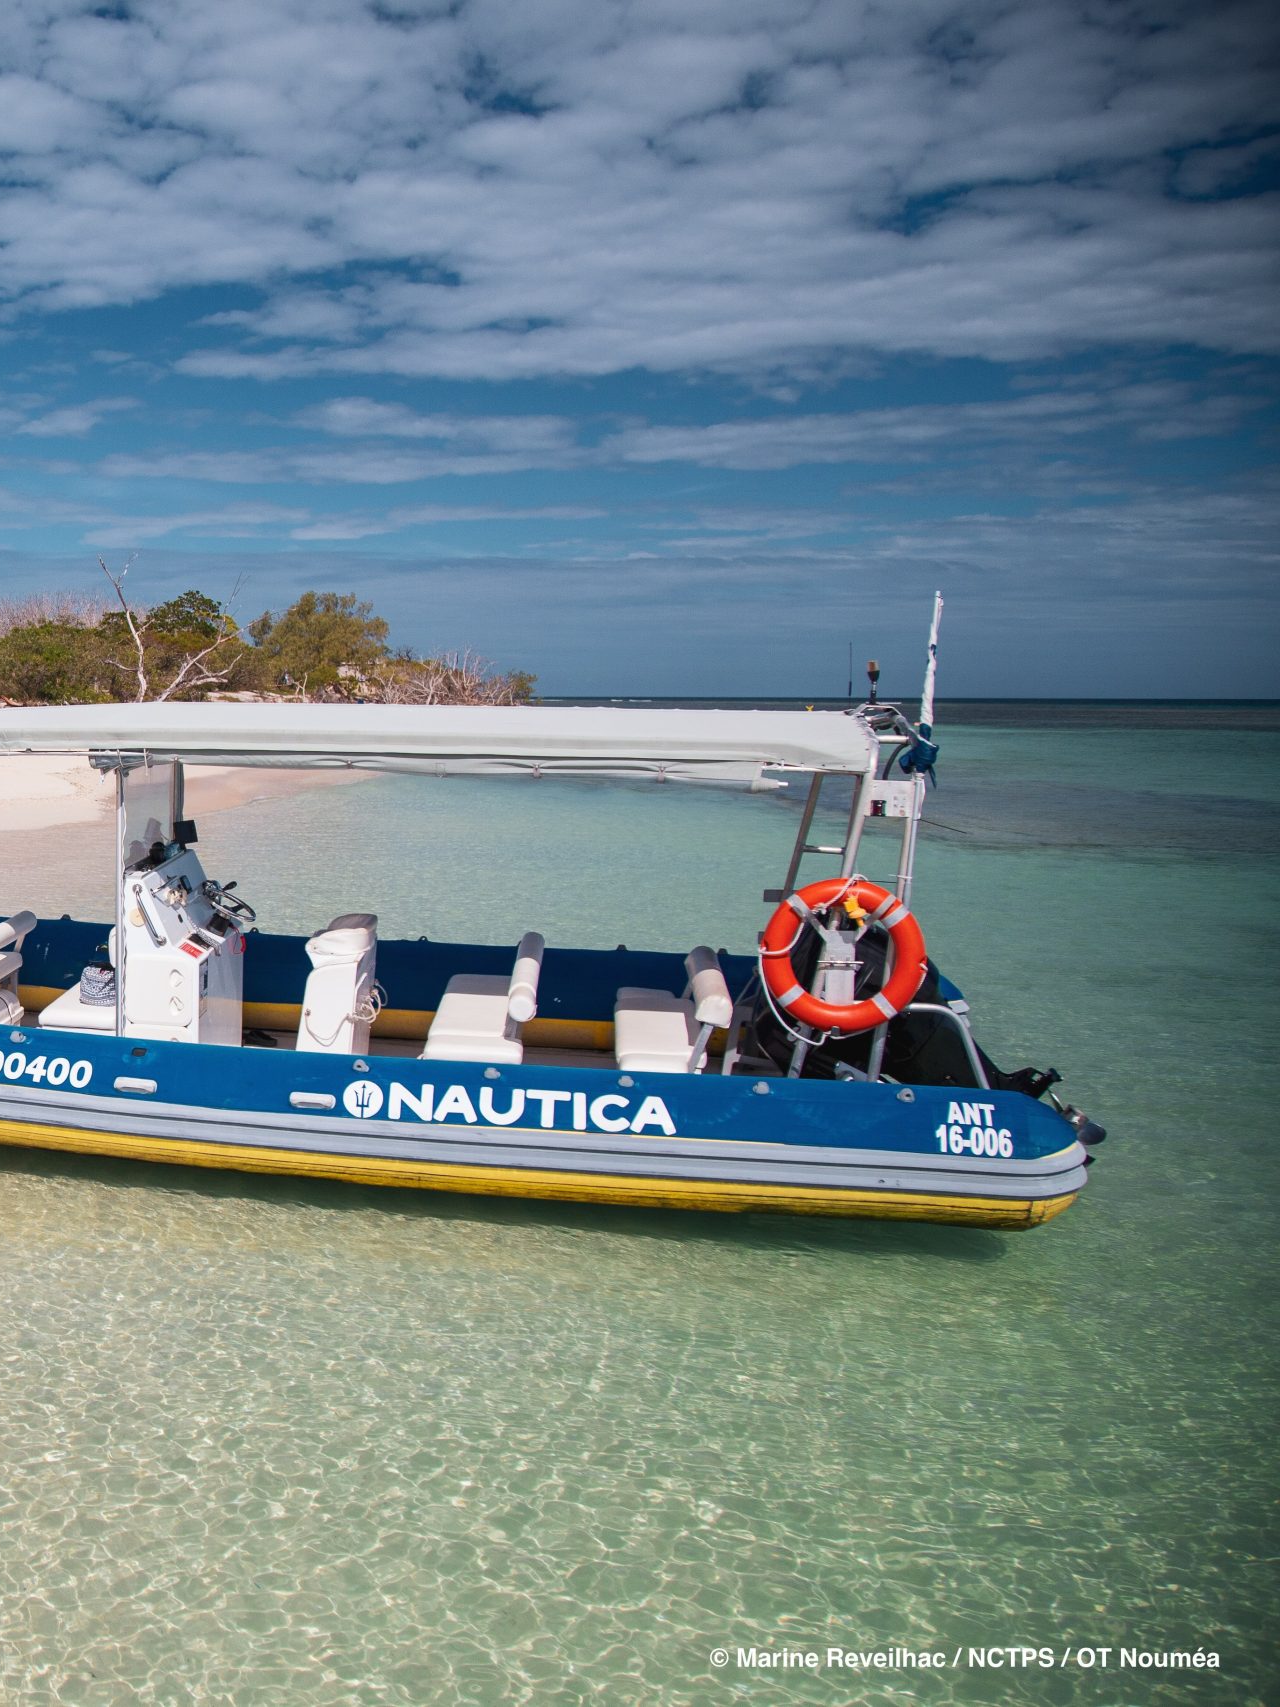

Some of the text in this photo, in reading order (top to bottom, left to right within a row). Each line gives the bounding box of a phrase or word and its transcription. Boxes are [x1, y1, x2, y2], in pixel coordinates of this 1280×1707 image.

[387, 1081, 677, 1136] NAUTICA
[947, 1101, 996, 1128] ANT
[935, 1124, 1014, 1158] 16-006
